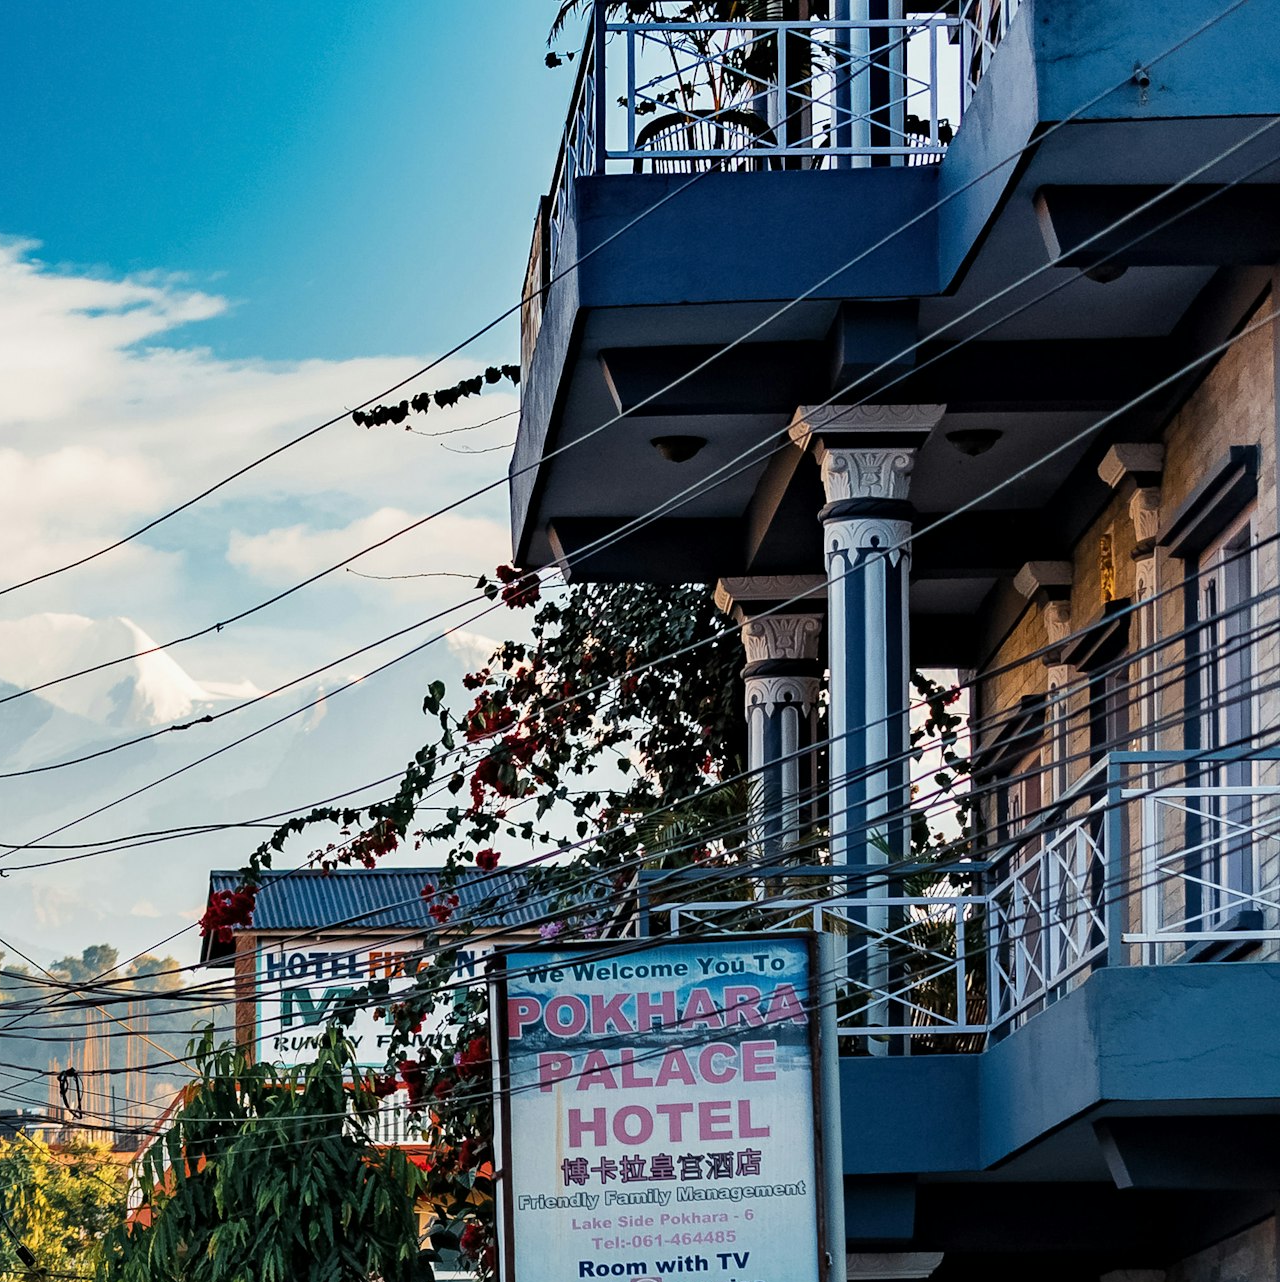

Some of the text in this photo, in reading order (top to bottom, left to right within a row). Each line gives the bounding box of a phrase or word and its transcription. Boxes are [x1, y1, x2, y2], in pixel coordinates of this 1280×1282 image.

[266, 952, 364, 980] HOTEL
[369, 952, 429, 979] FI
[526, 953, 786, 984] We Welcome You To
[508, 982, 809, 1039] POKHARA
[539, 1040, 778, 1093] PALACE
[568, 1099, 771, 1149] HOTEL
[560, 1147, 762, 1187] 博卡拉皇宫酒店
[518, 1180, 807, 1211] Friendly Family Management
[572, 1218, 612, 1231] Lake
[618, 1215, 654, 1229] Side
[661, 1212, 729, 1227] Pokhara
[743, 1208, 755, 1221] 6
[578, 1251, 751, 1278] Room with TV
